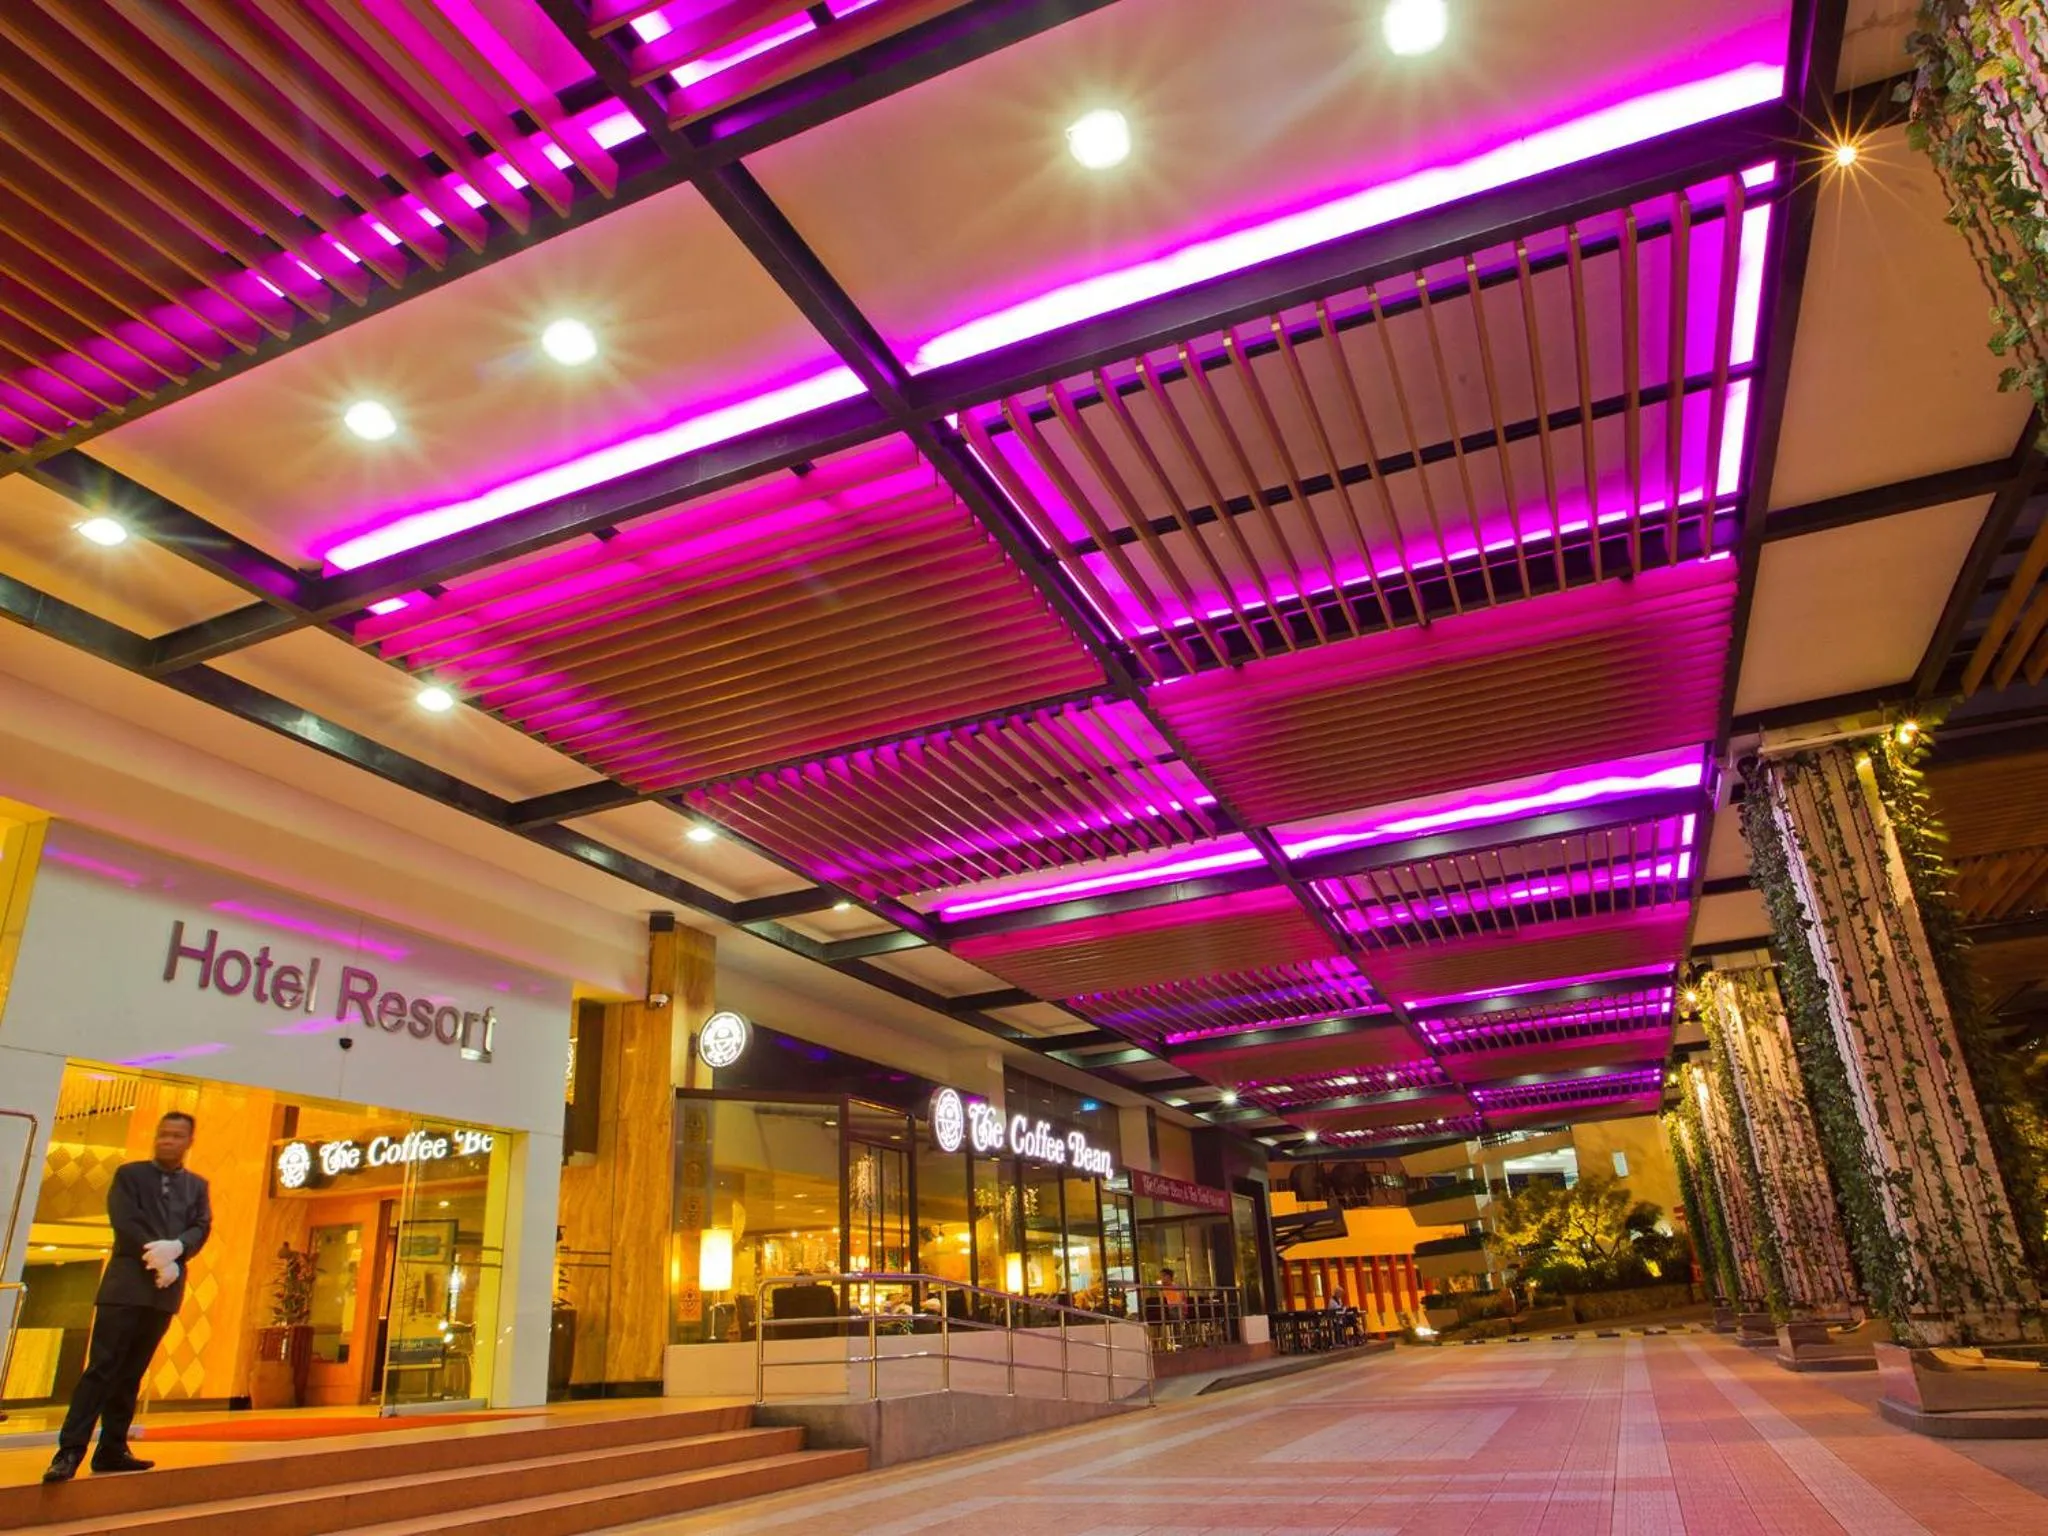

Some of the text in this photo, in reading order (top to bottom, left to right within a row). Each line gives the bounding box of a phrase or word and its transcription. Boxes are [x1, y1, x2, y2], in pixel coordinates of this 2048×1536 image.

[163, 919, 497, 1062] Hotel Resort
[319, 1140, 361, 1175] The
[367, 1130, 448, 1166] Coffee
[968, 1103, 1004, 1152] The
[1010, 1114, 1066, 1164] Coffee
[1067, 1131, 1115, 1180] Bean
